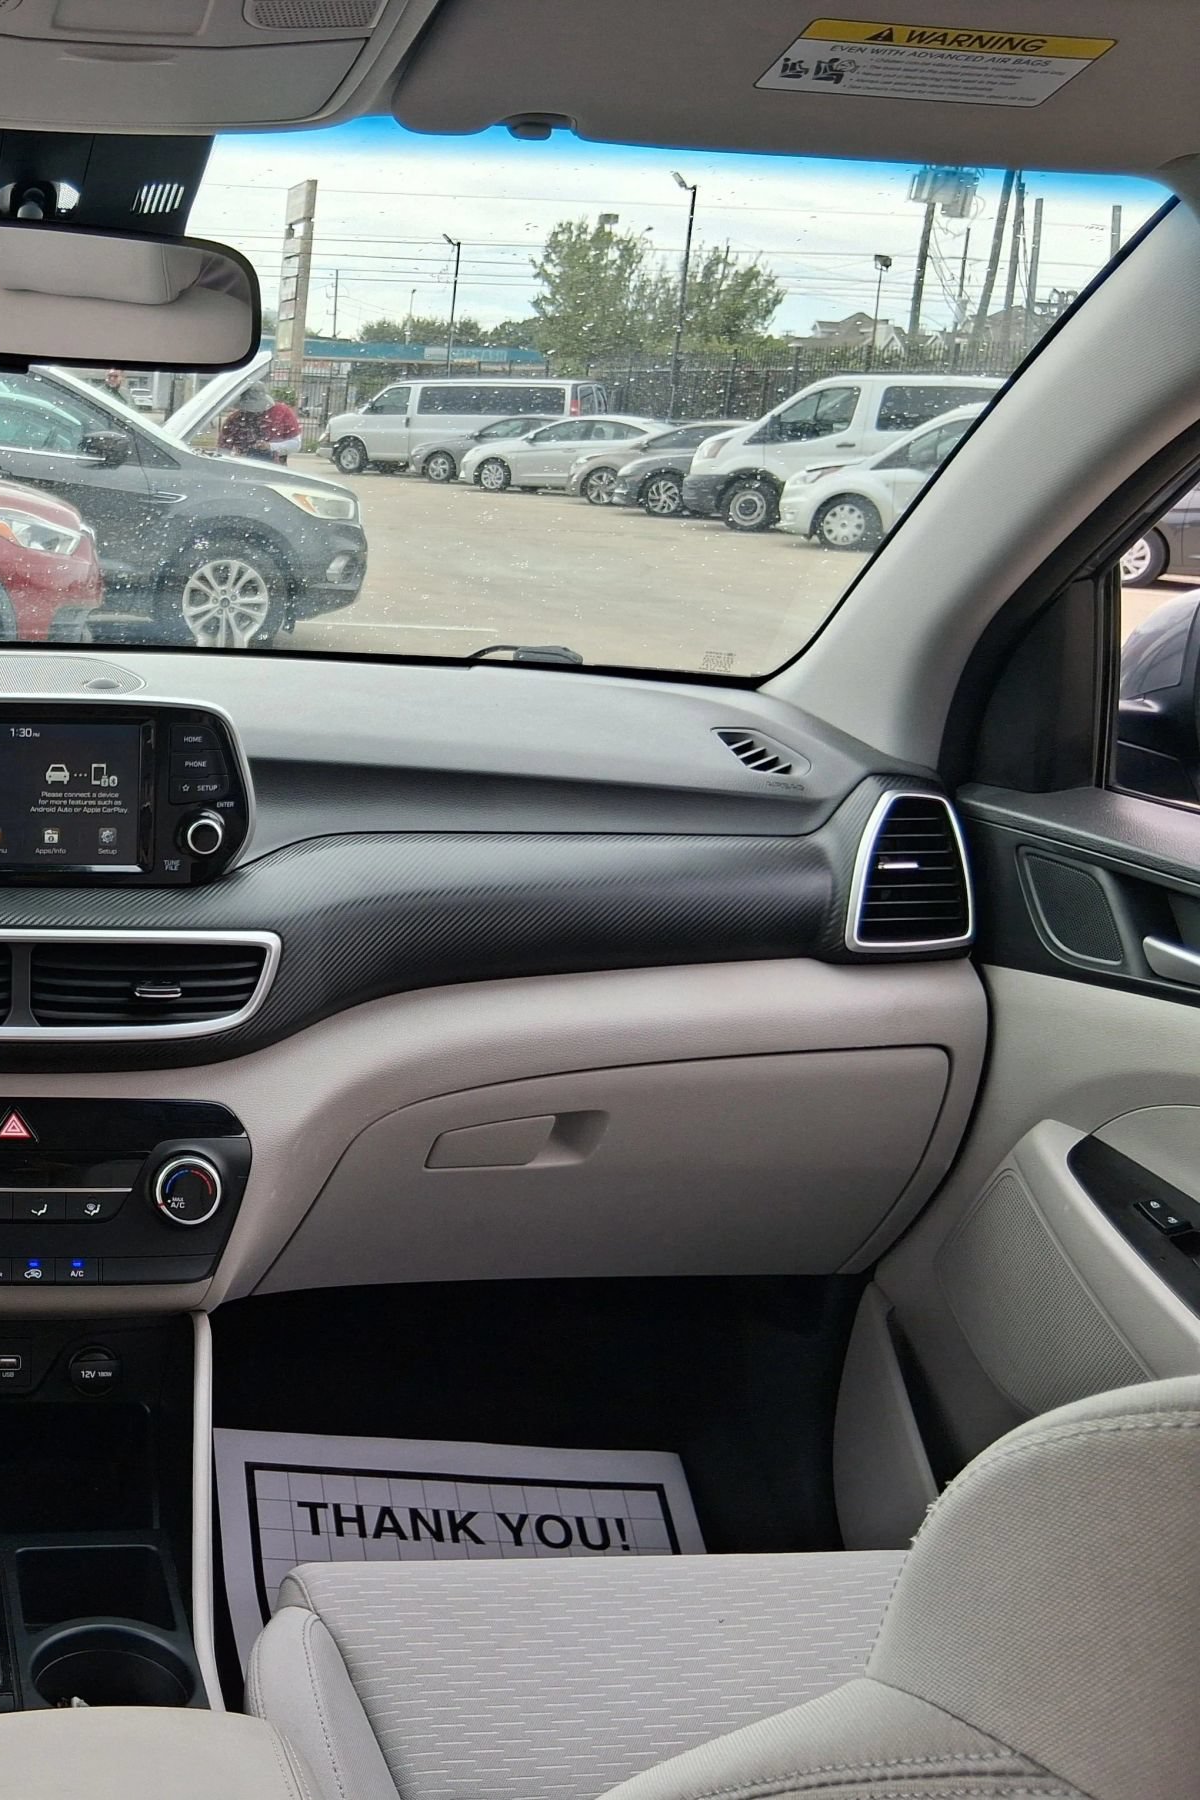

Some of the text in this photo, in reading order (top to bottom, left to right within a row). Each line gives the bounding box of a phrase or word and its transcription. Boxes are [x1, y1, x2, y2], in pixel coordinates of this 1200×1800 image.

[906, 29, 1048, 53] WARNING
[830, 45, 865, 54] EVEN
[869, 47, 905, 57] WITH
[908, 51, 985, 63] ADVANCED
[986, 57, 1010, 65] AIR
[1012, 58, 1052, 67] BAGS
[10, 728, 32, 738] 1:30
[80, 1370, 96, 1379] 12V
[297, 1500, 632, 1552] THANK YOU!
